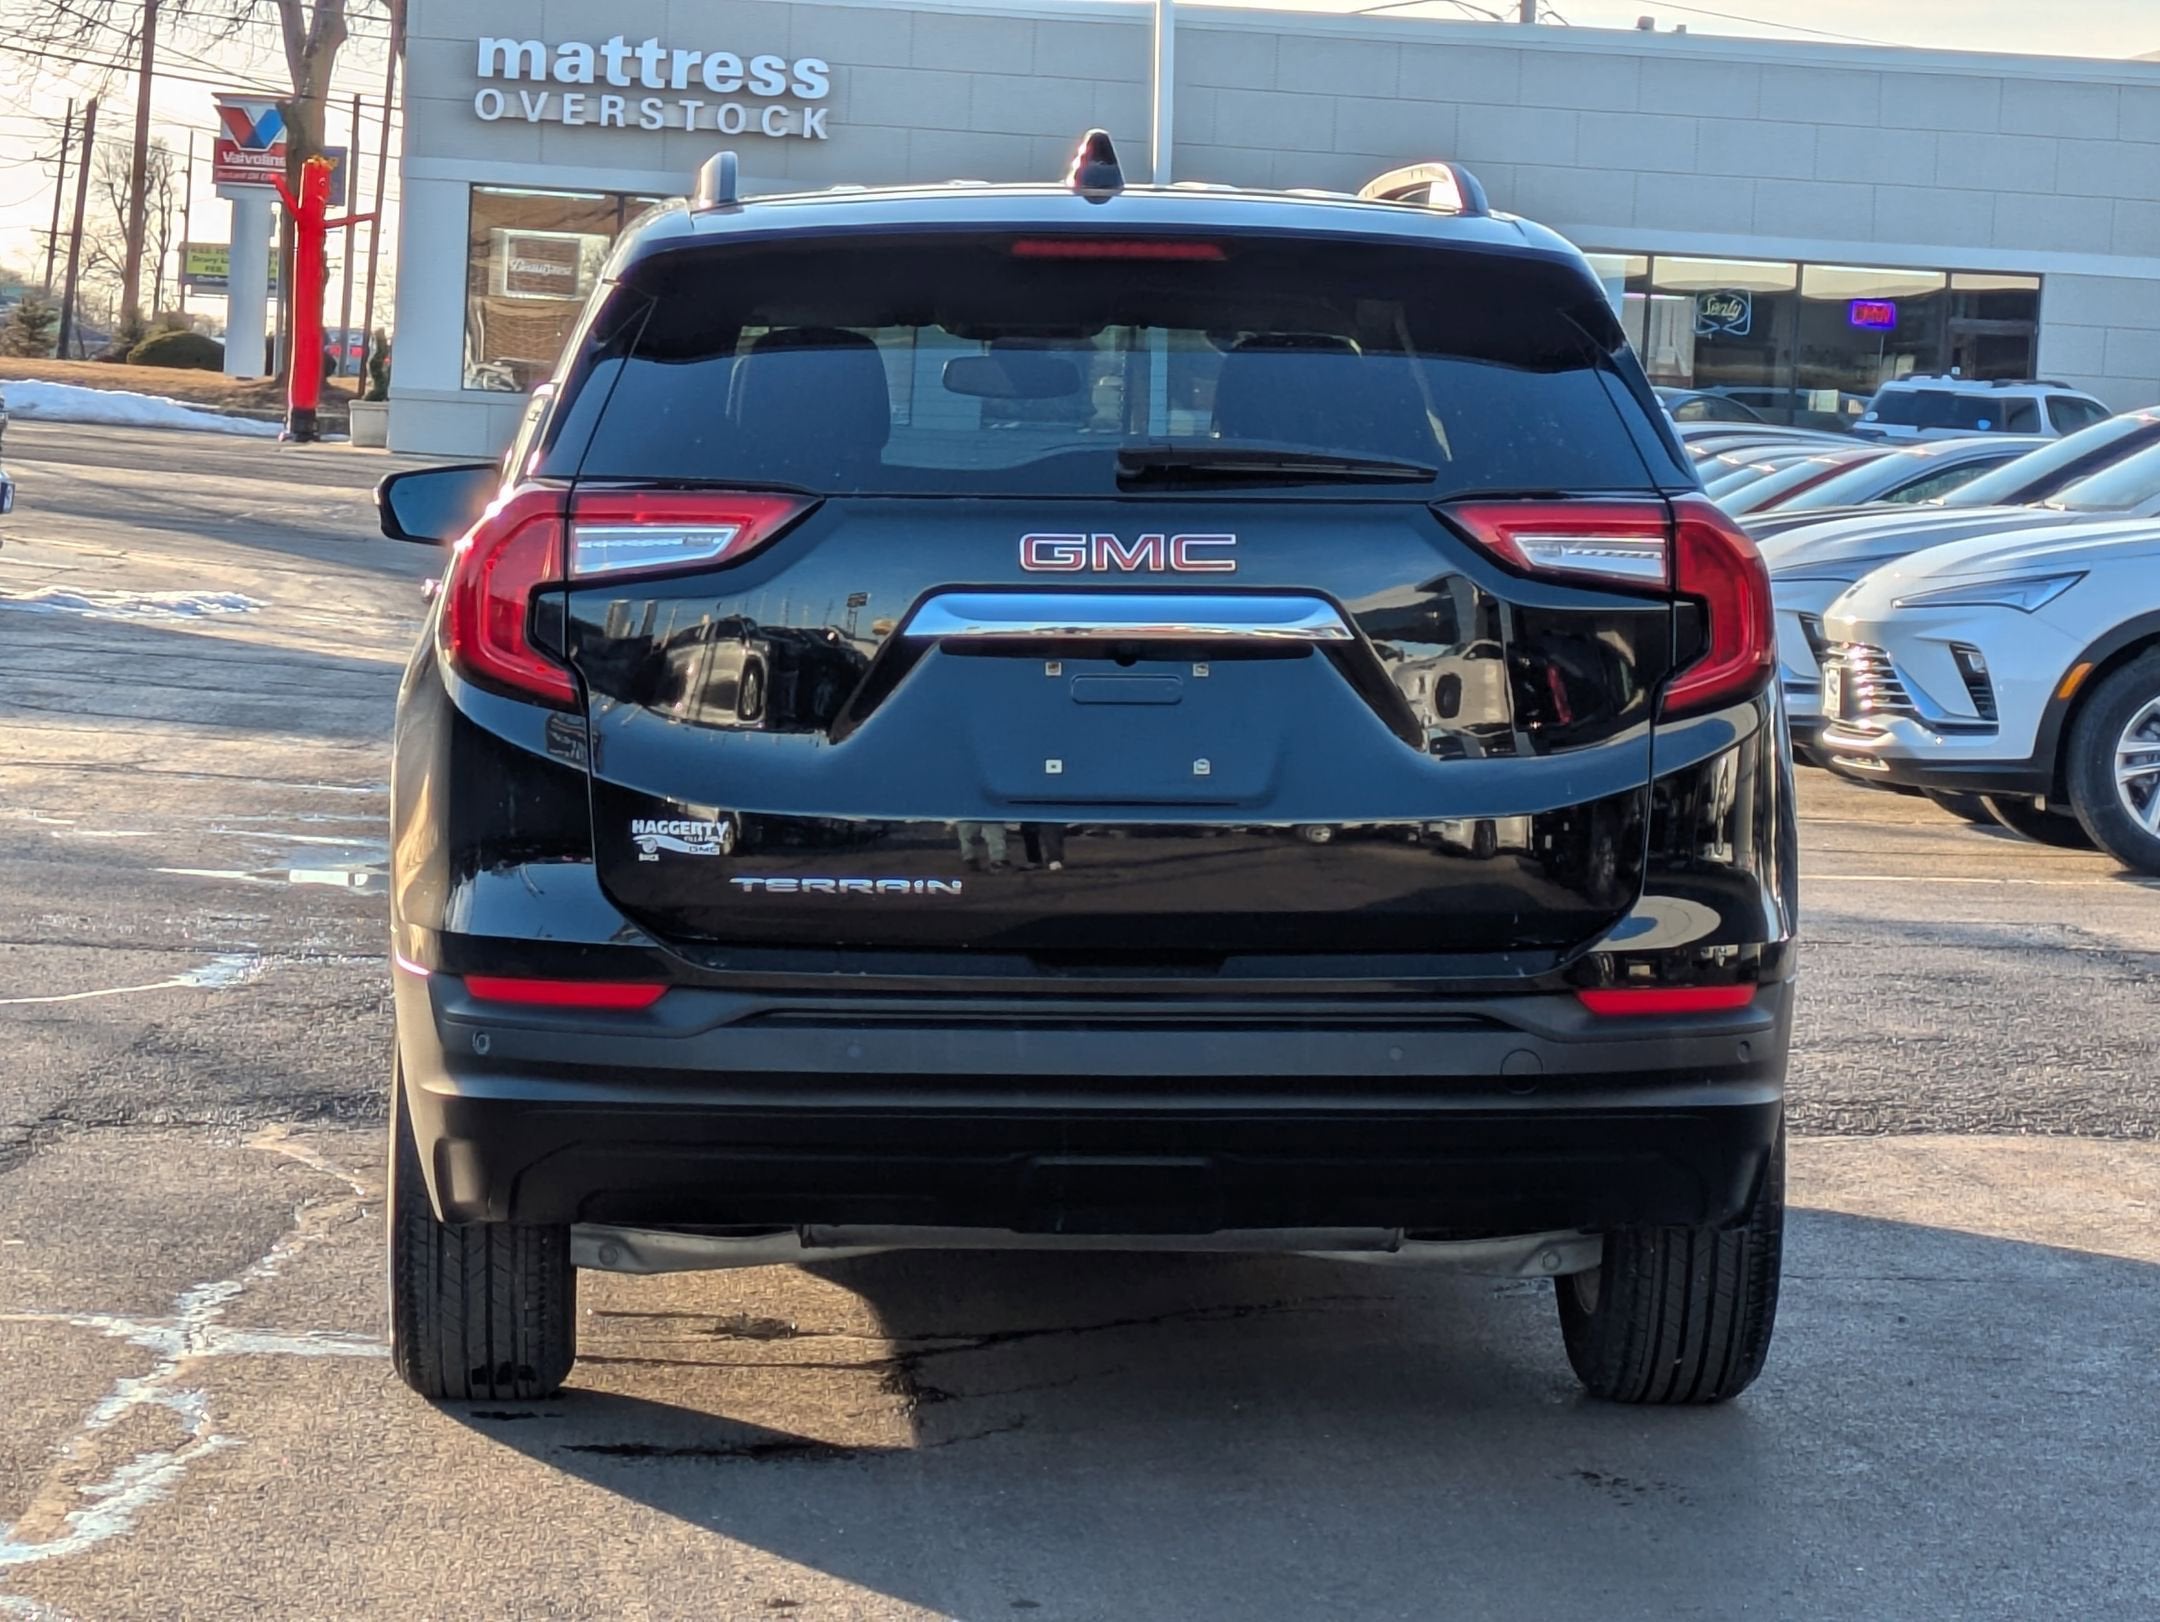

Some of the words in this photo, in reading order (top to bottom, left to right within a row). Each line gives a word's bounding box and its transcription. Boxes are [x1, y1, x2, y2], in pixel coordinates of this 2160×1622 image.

[477, 35, 830, 99] mattress
[474, 88, 830, 140] OVERSTOCK
[1019, 532, 1237, 572] GMC
[631, 819, 730, 841] HAGGERTY
[730, 877, 963, 895] TERRAIN
